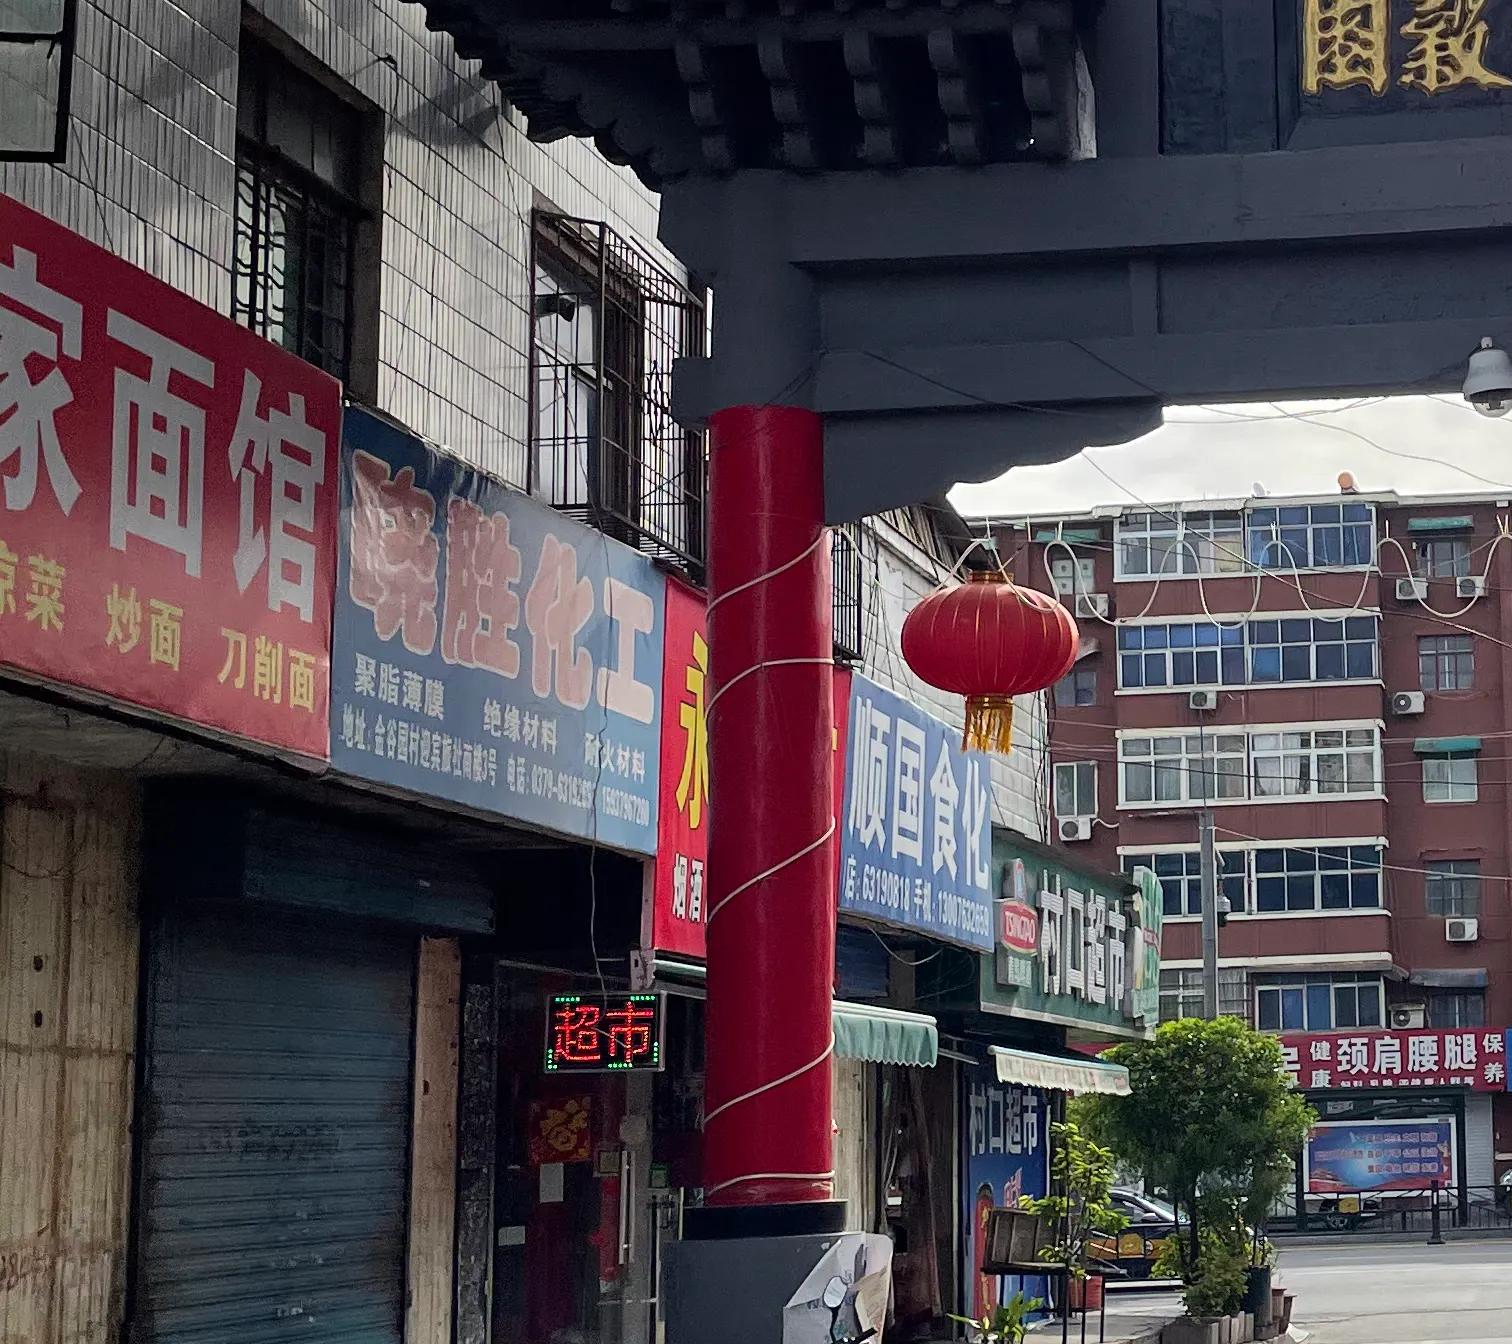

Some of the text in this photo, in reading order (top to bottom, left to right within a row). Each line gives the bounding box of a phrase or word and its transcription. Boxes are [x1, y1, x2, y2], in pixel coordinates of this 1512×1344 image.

[105, 582, 184, 671] 炒面
[217, 626, 316, 713] 刀削面
[482, 697, 558, 756] 绝缘材料
[584, 731, 646, 785] 耐火材料
[849, 695, 989, 891] 顺国食化
[1041, 869, 1126, 1011] 村口超市
[554, 1000, 654, 1063] 超市
[1336, 1033, 1478, 1076] 颈肩腰腿
[1482, 1032, 1505, 1084] 保养
[969, 1082, 1038, 1156] 村口超市
